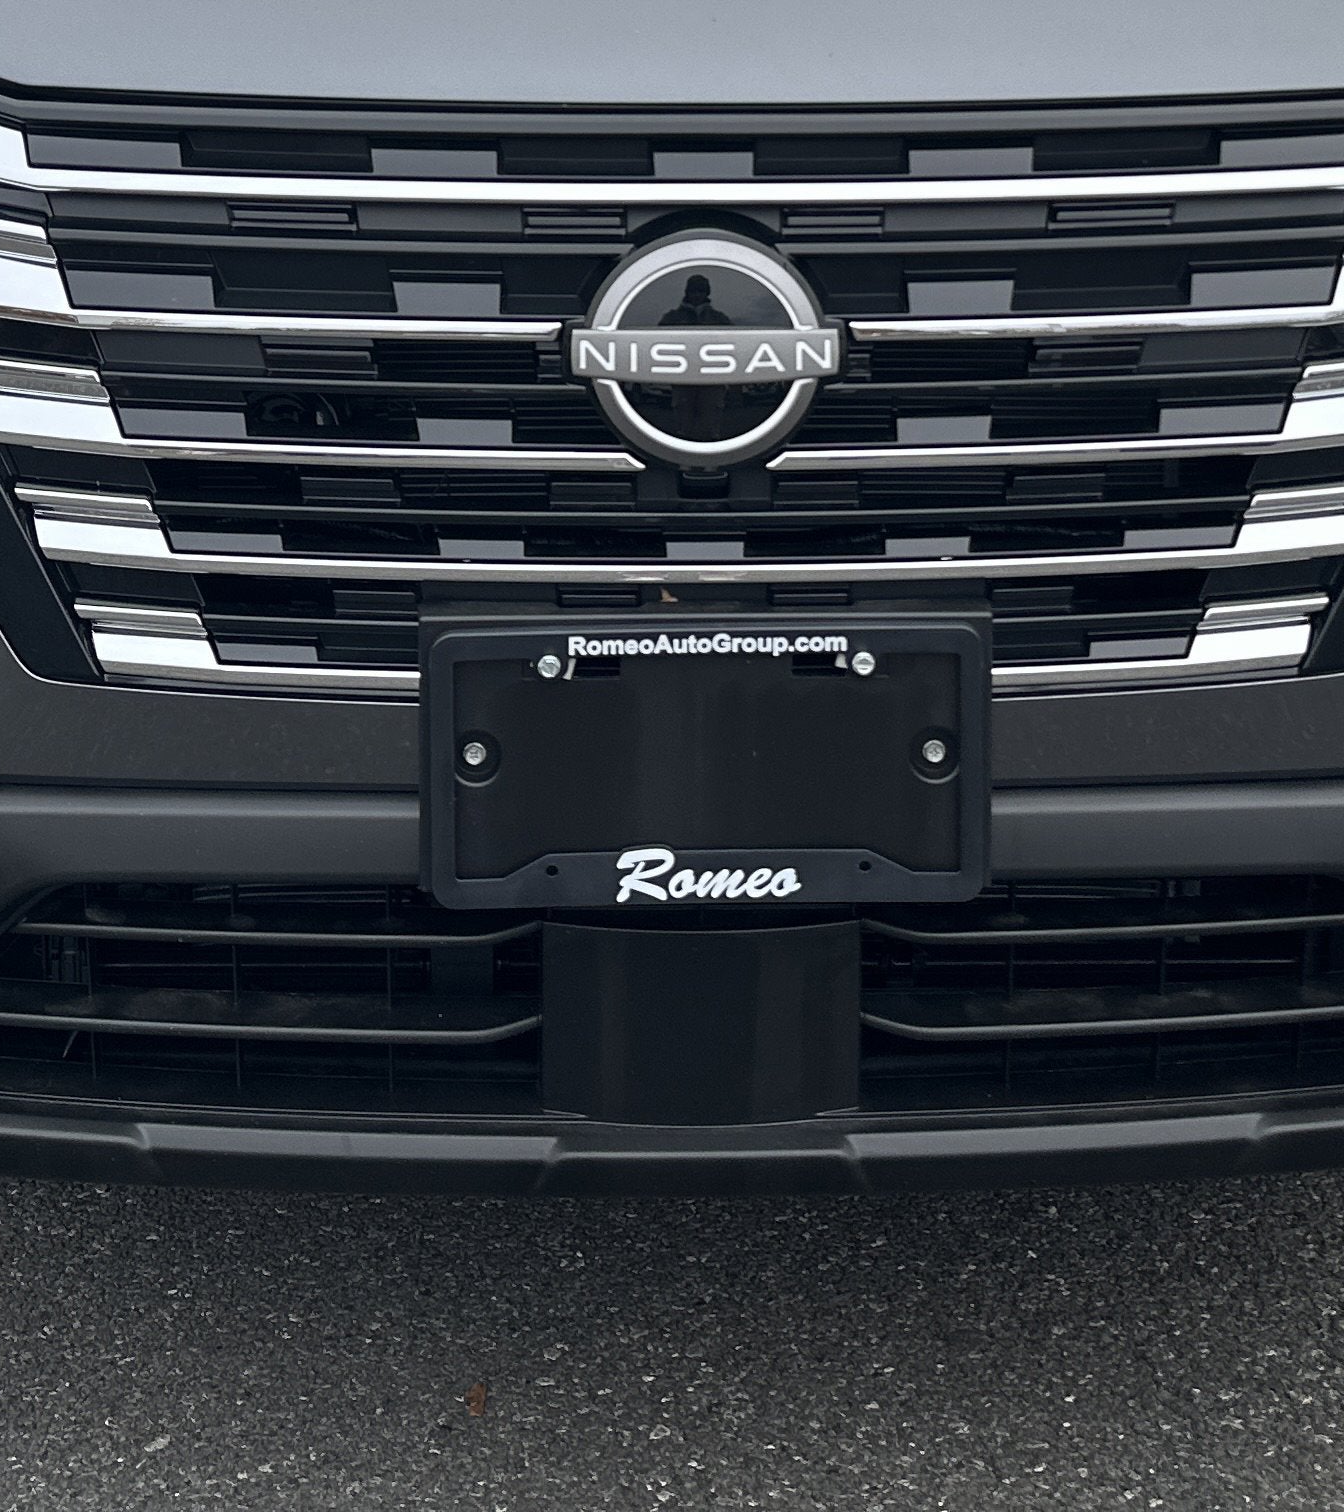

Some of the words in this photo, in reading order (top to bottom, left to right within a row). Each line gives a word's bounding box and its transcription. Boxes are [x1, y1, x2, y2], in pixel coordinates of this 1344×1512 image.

[579, 339, 832, 374] NISSAN
[568, 633, 848, 656] RomeoAutoGroup.com
[616, 848, 801, 903] Romeo
